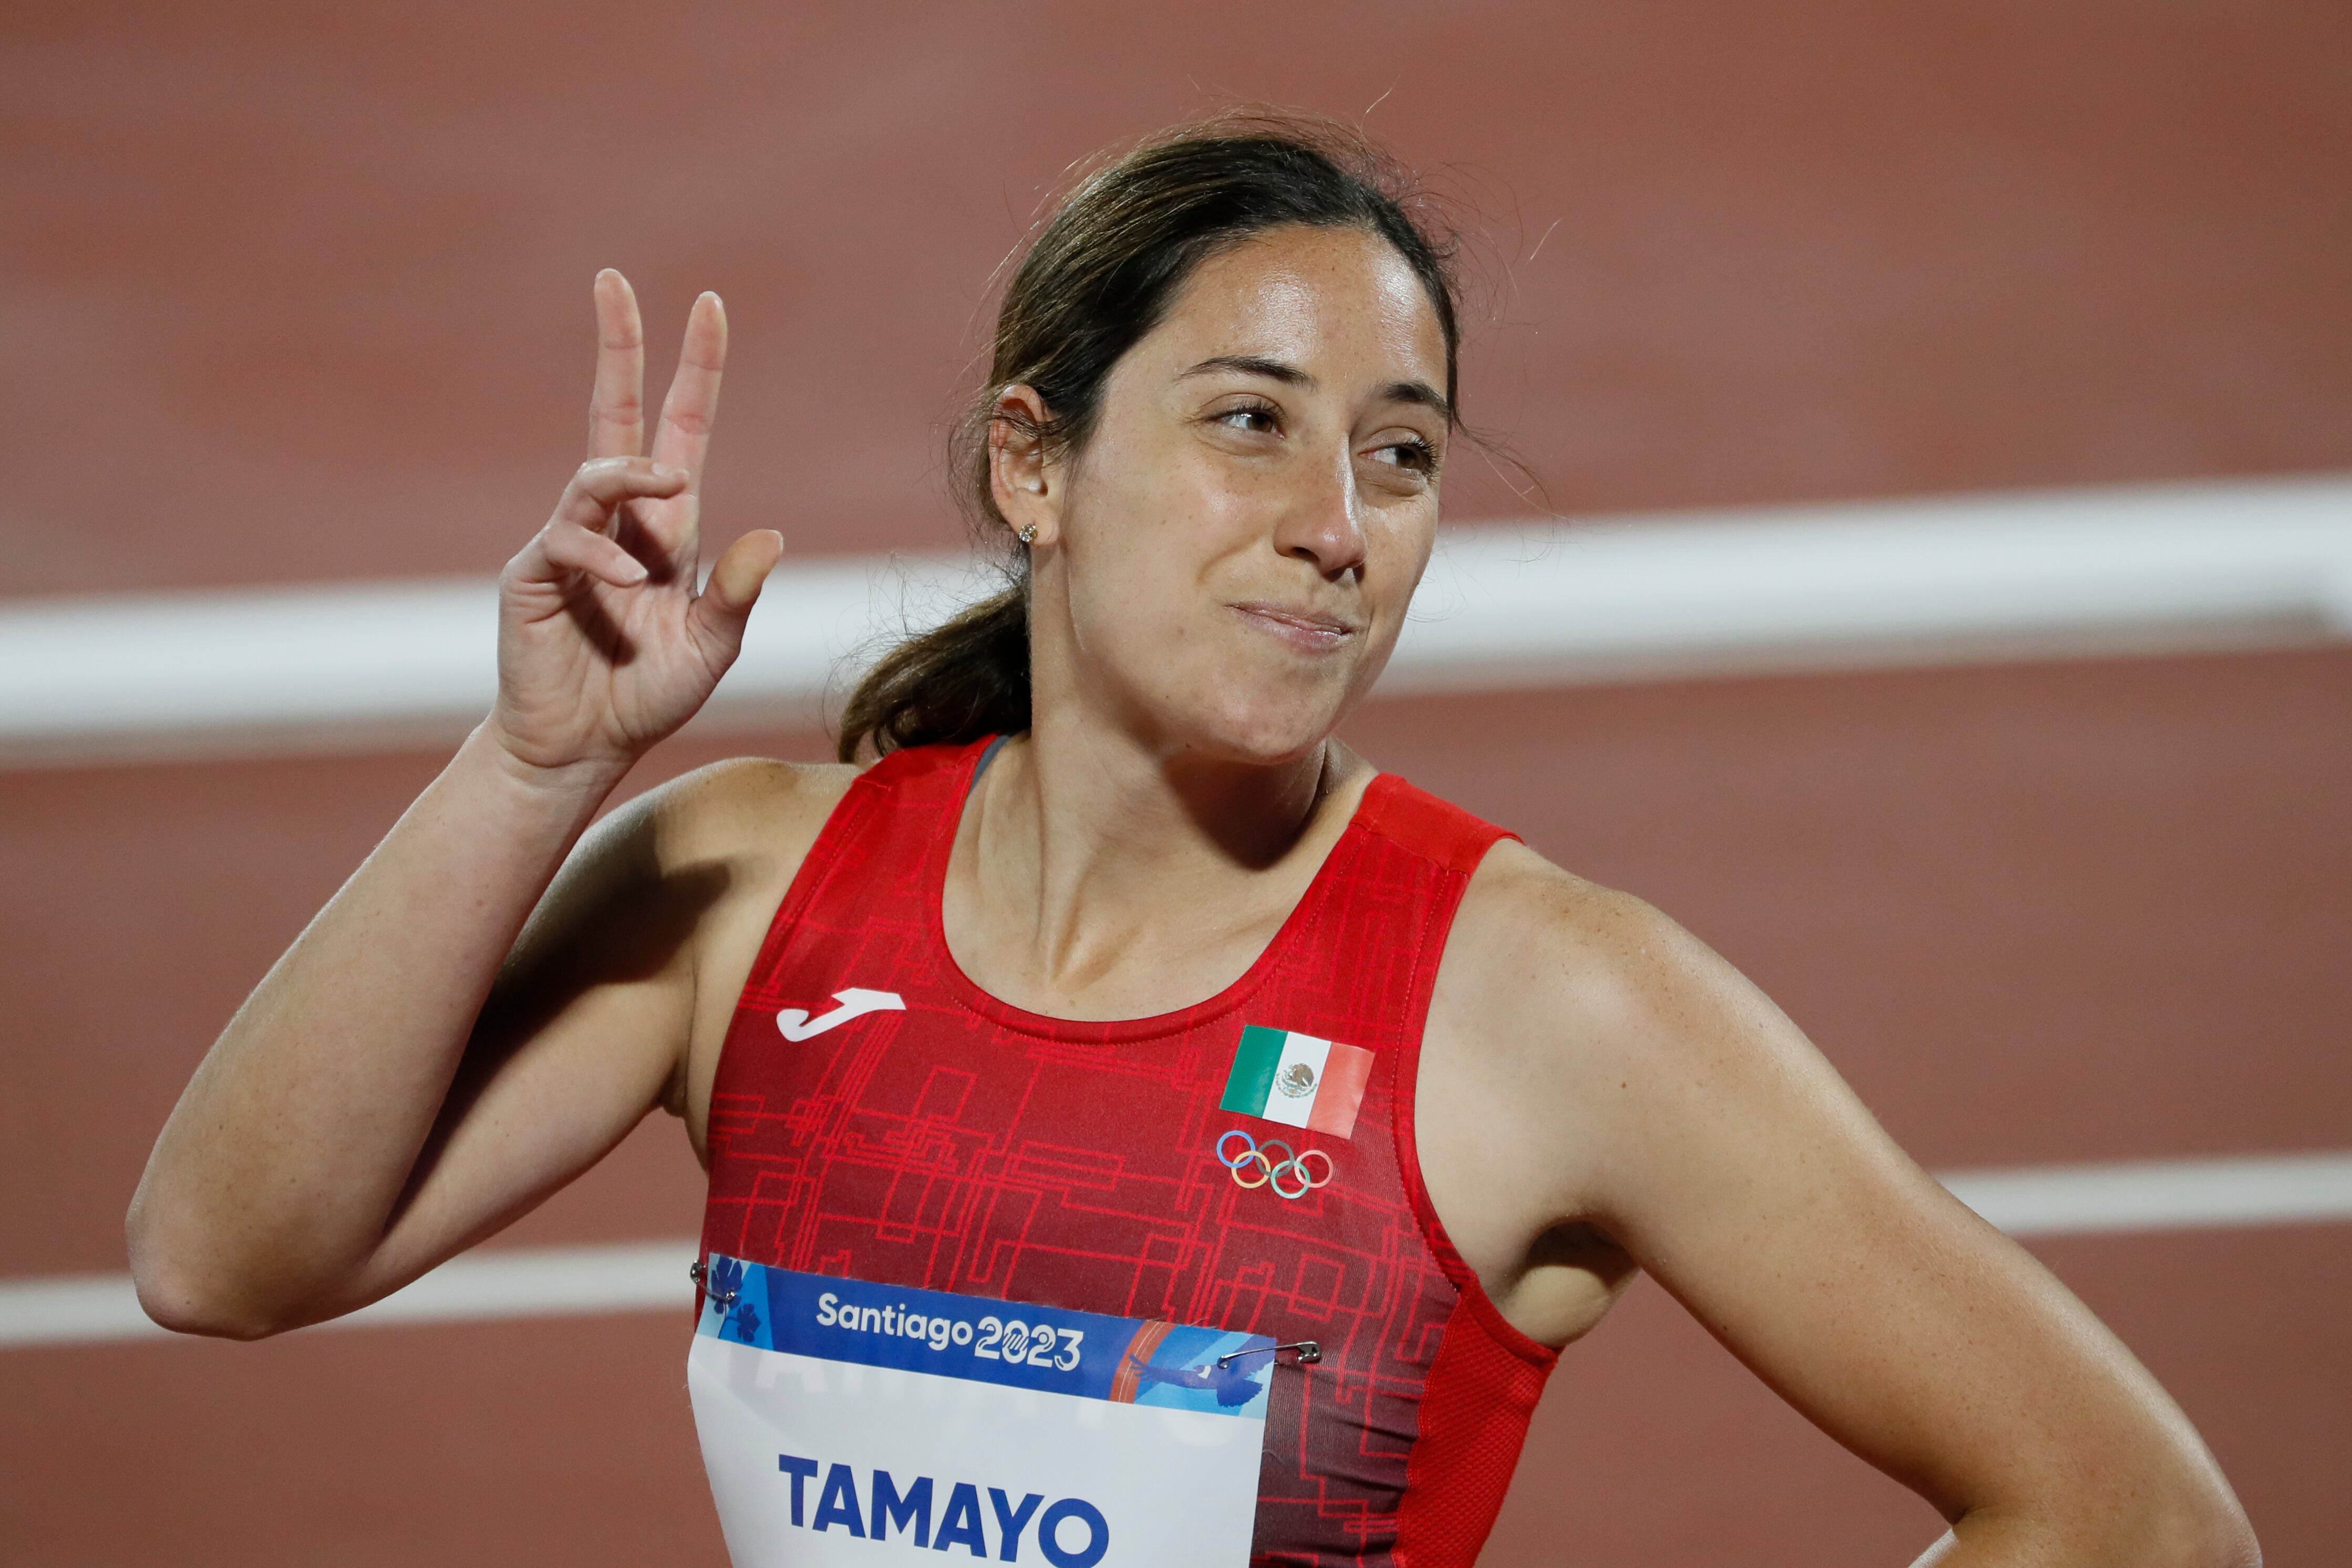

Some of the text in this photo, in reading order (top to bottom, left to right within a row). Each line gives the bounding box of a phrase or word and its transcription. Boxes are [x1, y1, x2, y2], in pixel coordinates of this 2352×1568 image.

[816, 1292, 1085, 1372] Santiago 2023
[778, 1454, 1109, 1568] TAMAYO
